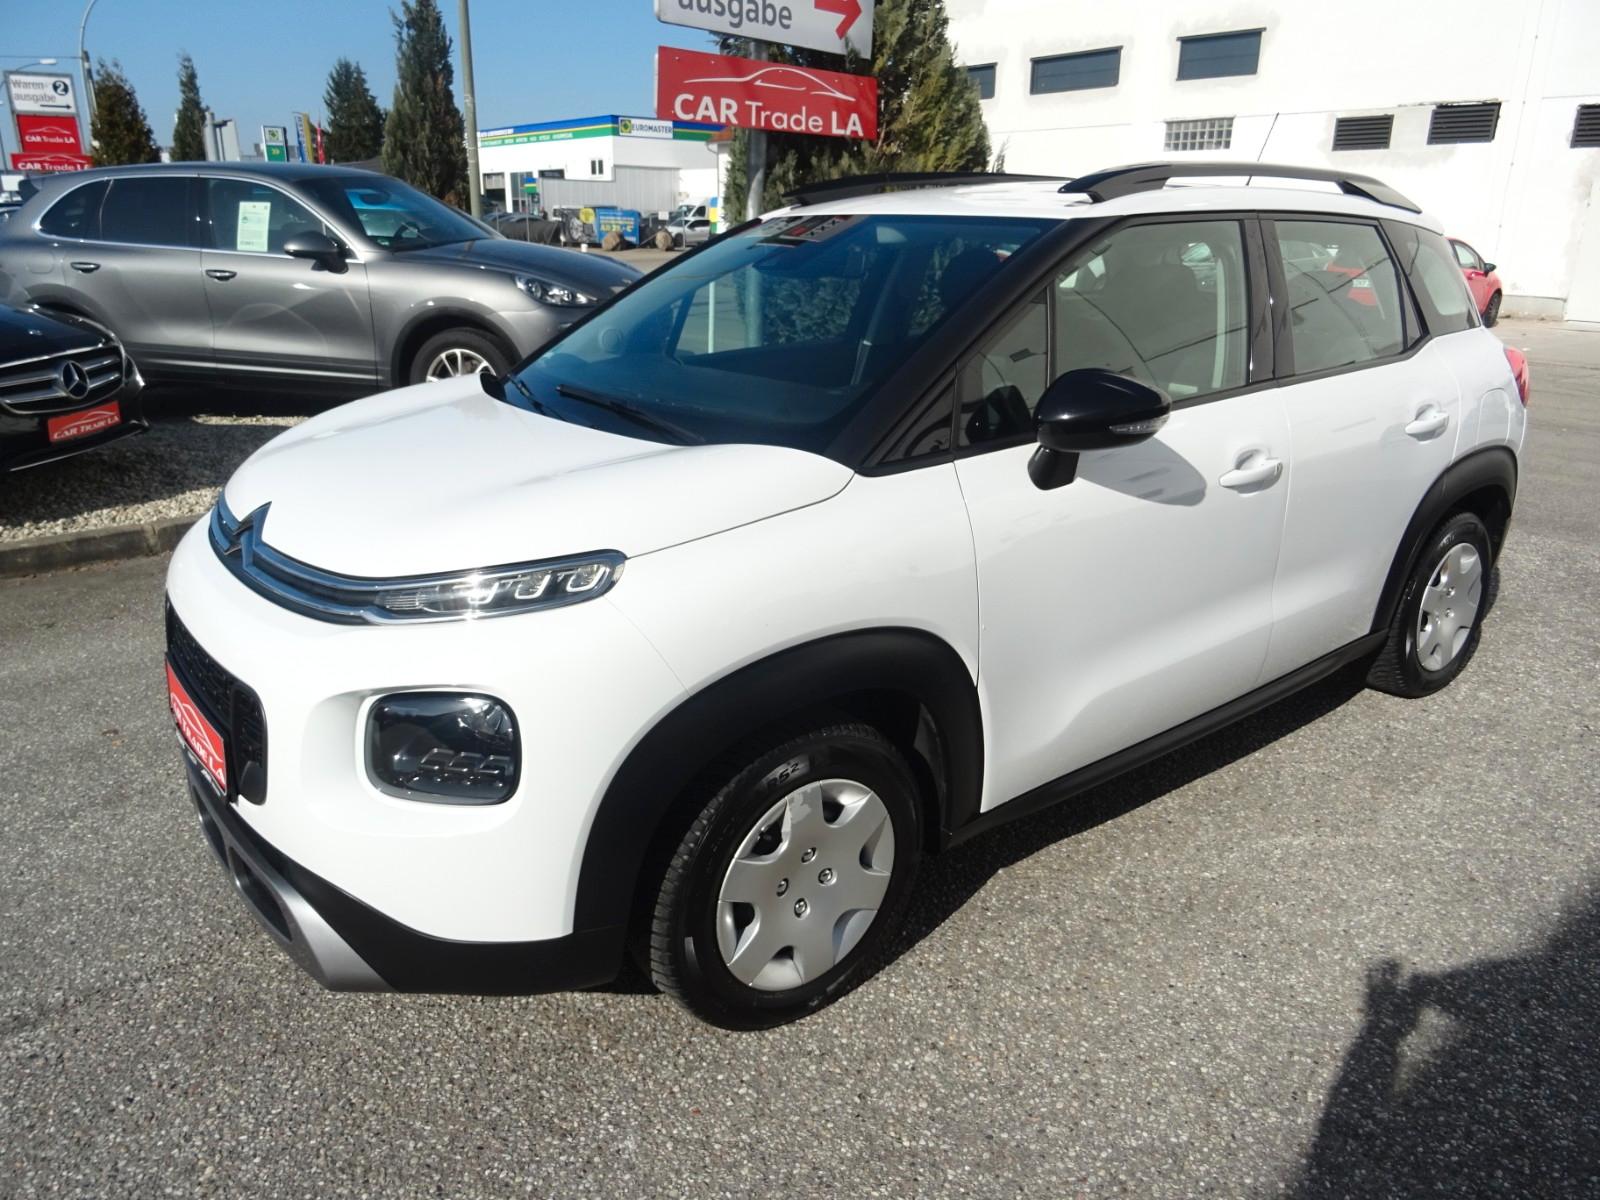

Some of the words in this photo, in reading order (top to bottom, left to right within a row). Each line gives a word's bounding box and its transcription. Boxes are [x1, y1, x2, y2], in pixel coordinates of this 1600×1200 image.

[14, 93, 56, 104] ausgabe
[674, 93, 738, 125] CAR
[745, 100, 823, 132] Trade
[831, 111, 864, 137] LA
[25, 134, 41, 142] CAR
[18, 162, 41, 170] CAR
[43, 163, 75, 171] Trade
[54, 427, 77, 439] CAR
[208, 755, 226, 785] LA
